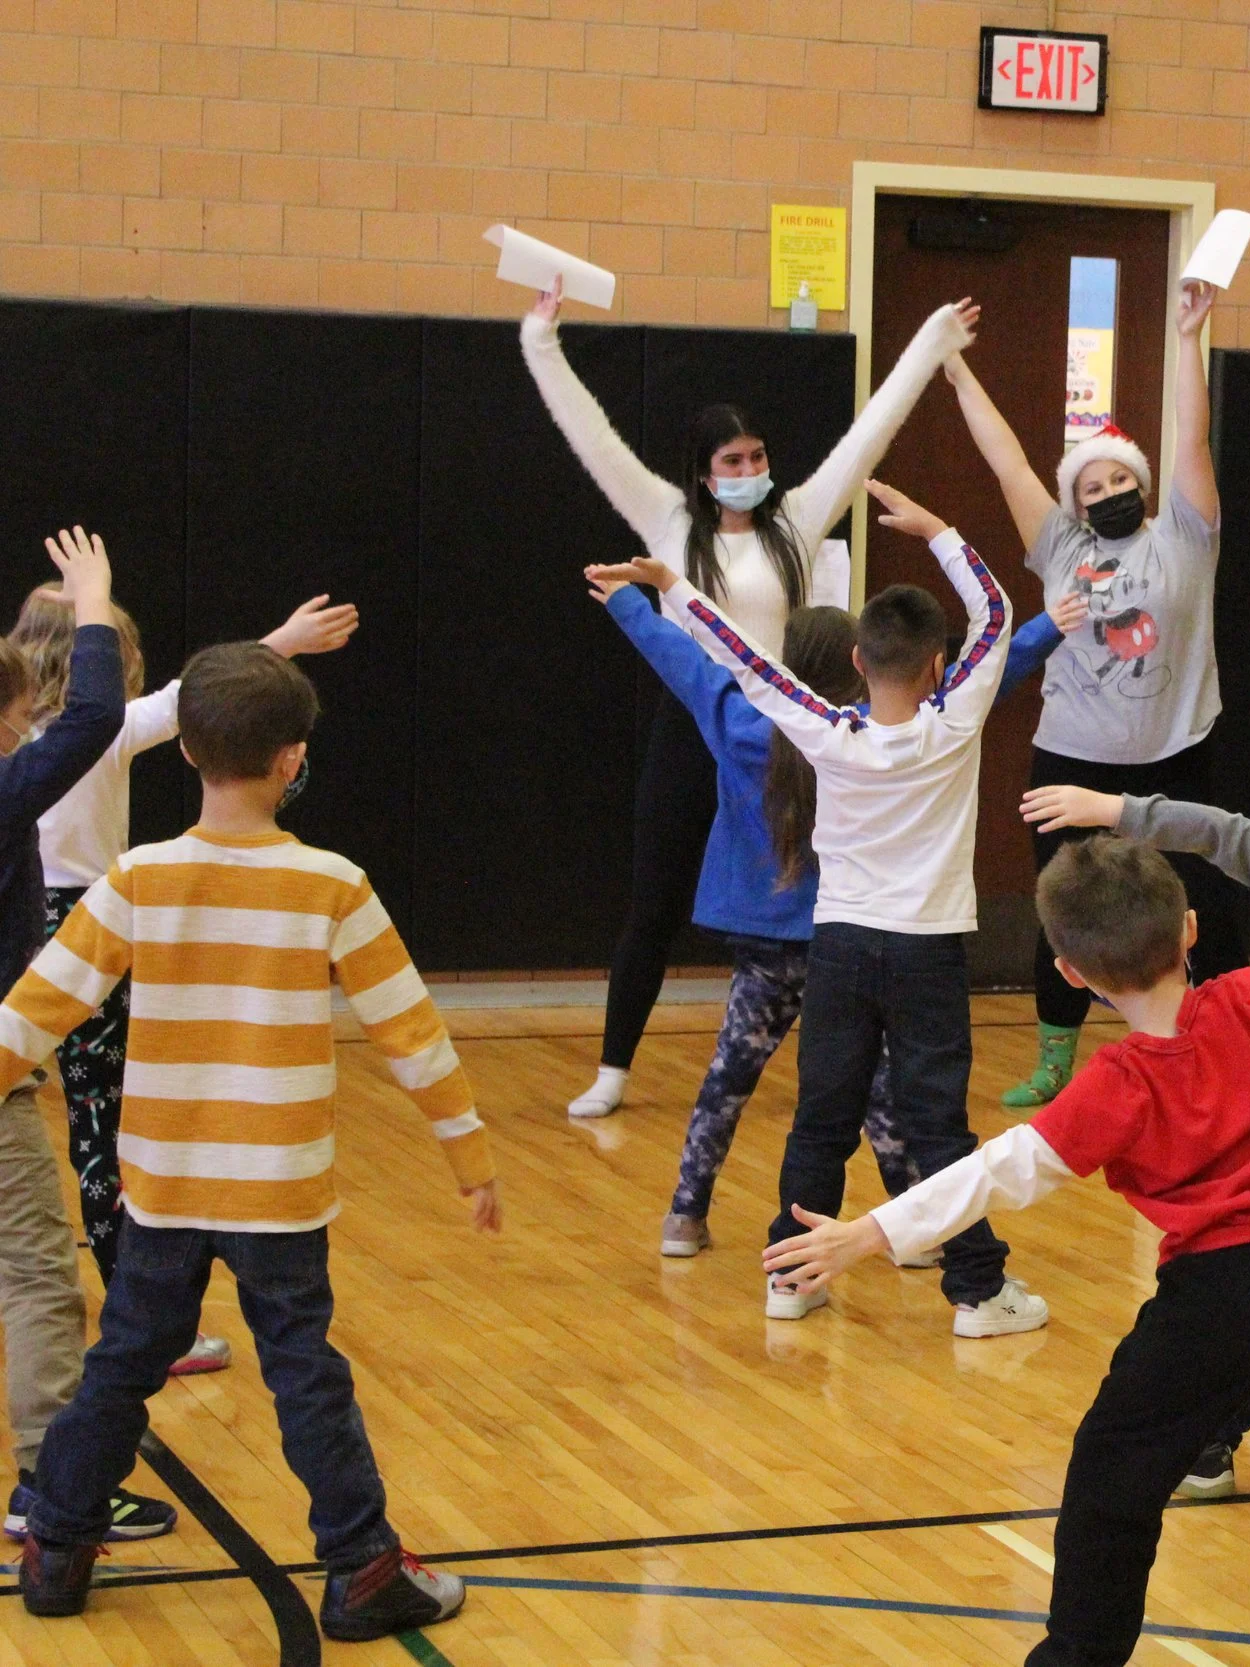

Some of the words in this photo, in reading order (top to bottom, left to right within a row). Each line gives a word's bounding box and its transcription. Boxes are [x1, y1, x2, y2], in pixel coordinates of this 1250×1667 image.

[1016, 42, 1085, 102] EXIT
[780, 215, 802, 226] FIRE
[805, 216, 836, 228] DRILL
